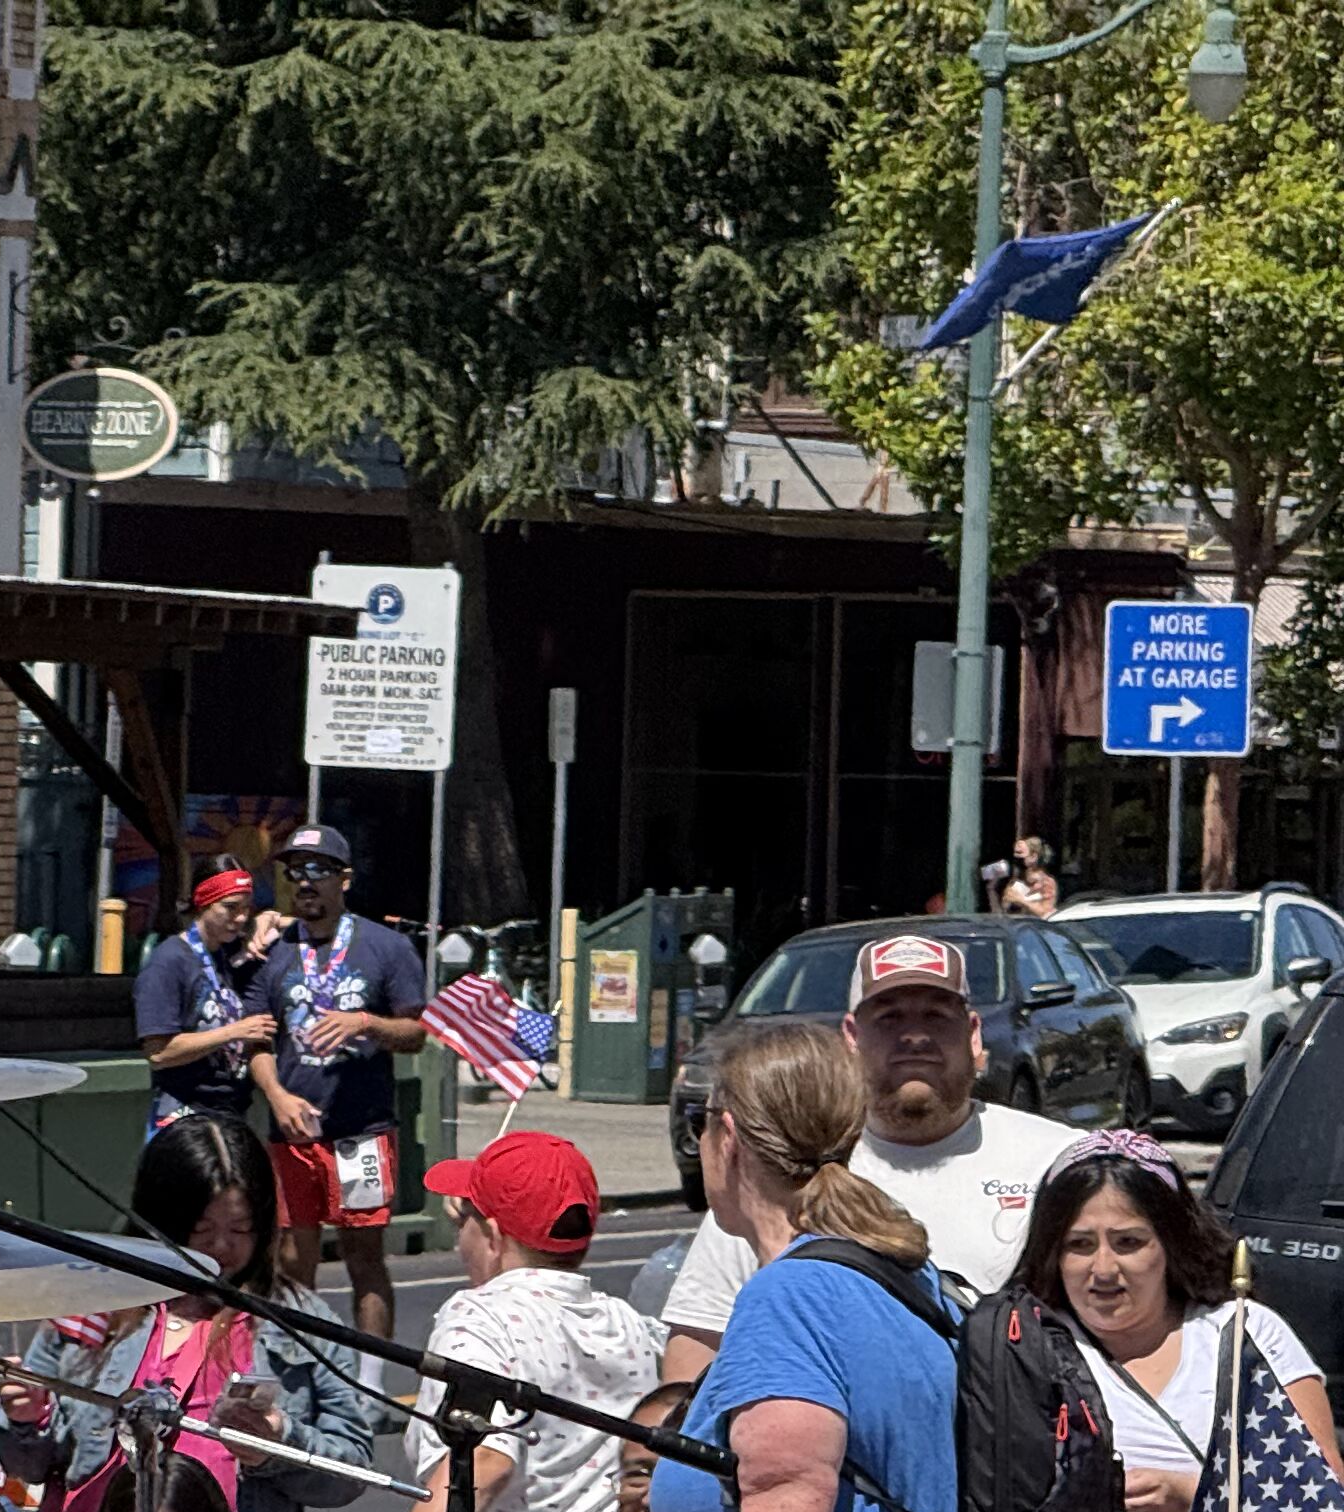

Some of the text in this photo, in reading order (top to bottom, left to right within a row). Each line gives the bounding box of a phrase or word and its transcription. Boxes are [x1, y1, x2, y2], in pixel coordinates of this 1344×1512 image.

[105, 411, 154, 436] ZONE
[1149, 614, 1208, 636] MORE
[320, 644, 446, 666] PUBLIC PARKING
[1132, 641, 1225, 663] PARKING
[326, 668, 438, 684] 2 HOUR PARKING
[1118, 668, 1238, 690] AT GARAGE
[320, 683, 377, 698] 9AM-6PM
[360, 1154, 381, 1191] 389
[1244, 1235, 1341, 1261] ML 350
